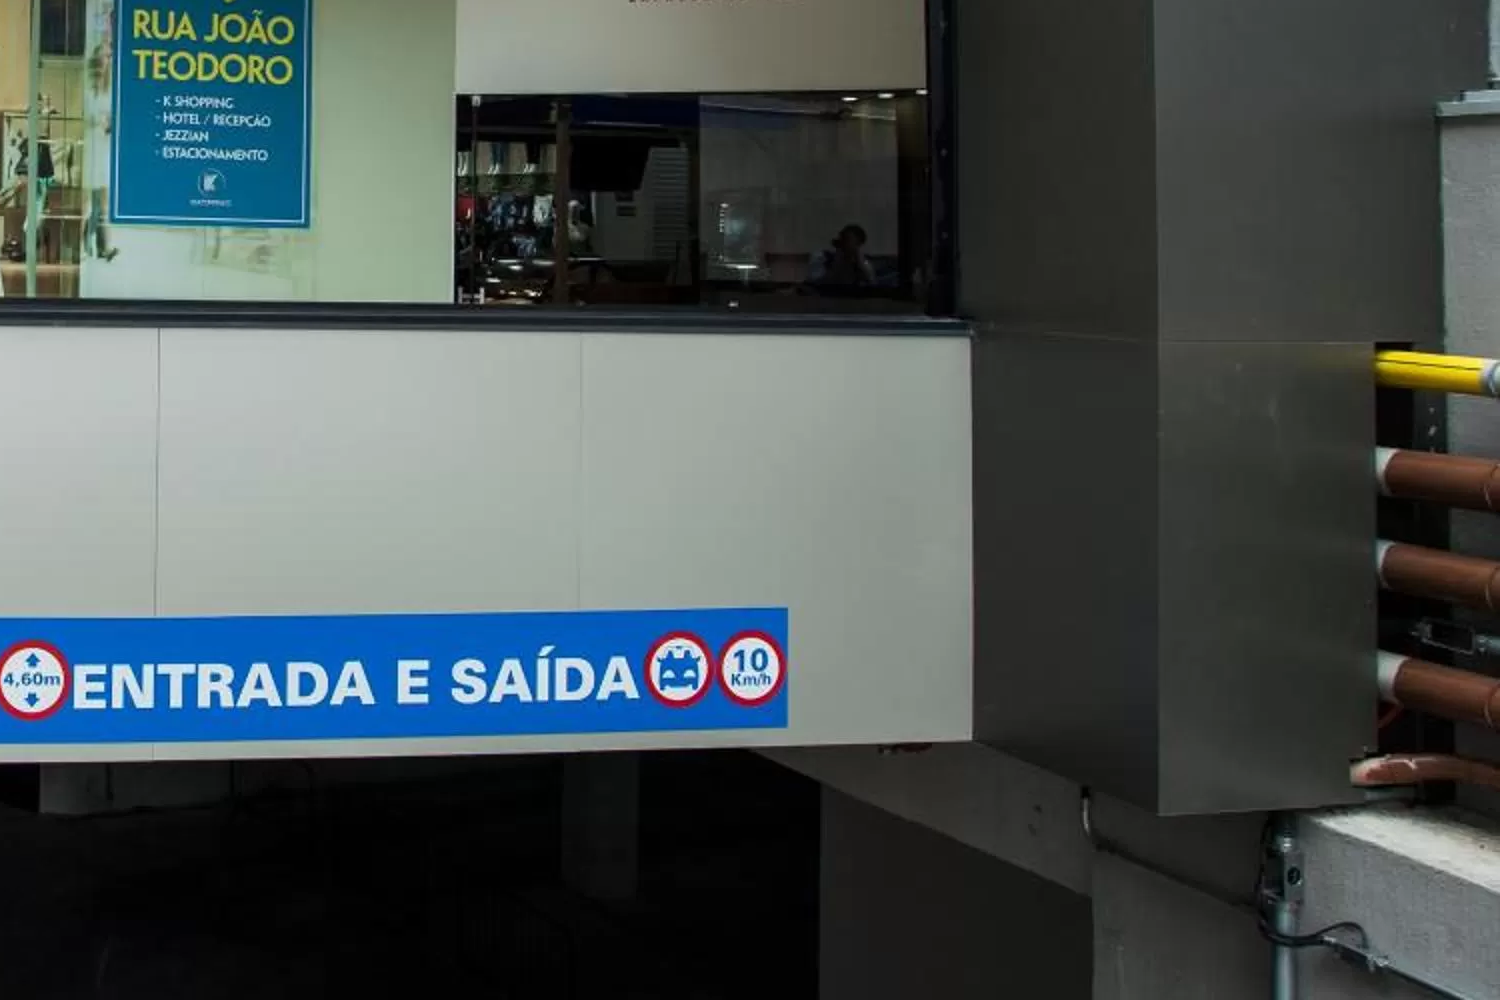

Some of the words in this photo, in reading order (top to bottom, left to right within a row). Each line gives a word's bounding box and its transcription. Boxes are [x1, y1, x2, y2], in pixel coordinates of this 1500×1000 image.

[133, 8, 196, 41] RUA
[203, 10, 295, 45] JOÃO
[132, 50, 293, 85] TEODORO
[163, 96, 171, 107] K
[175, 96, 234, 109] SHOPPING
[163, 112, 200, 125] HOTEL
[162, 129, 209, 142] JEZZIAN
[163, 146, 269, 161] ESTACIONAMENTO
[733, 648, 768, 673] 10
[3, 672, 62, 687] 4,60m
[73, 660, 375, 709] ENTRADA
[397, 659, 430, 704] E
[451, 645, 640, 704] SAÍDA
[731, 672, 772, 689] Km/h
